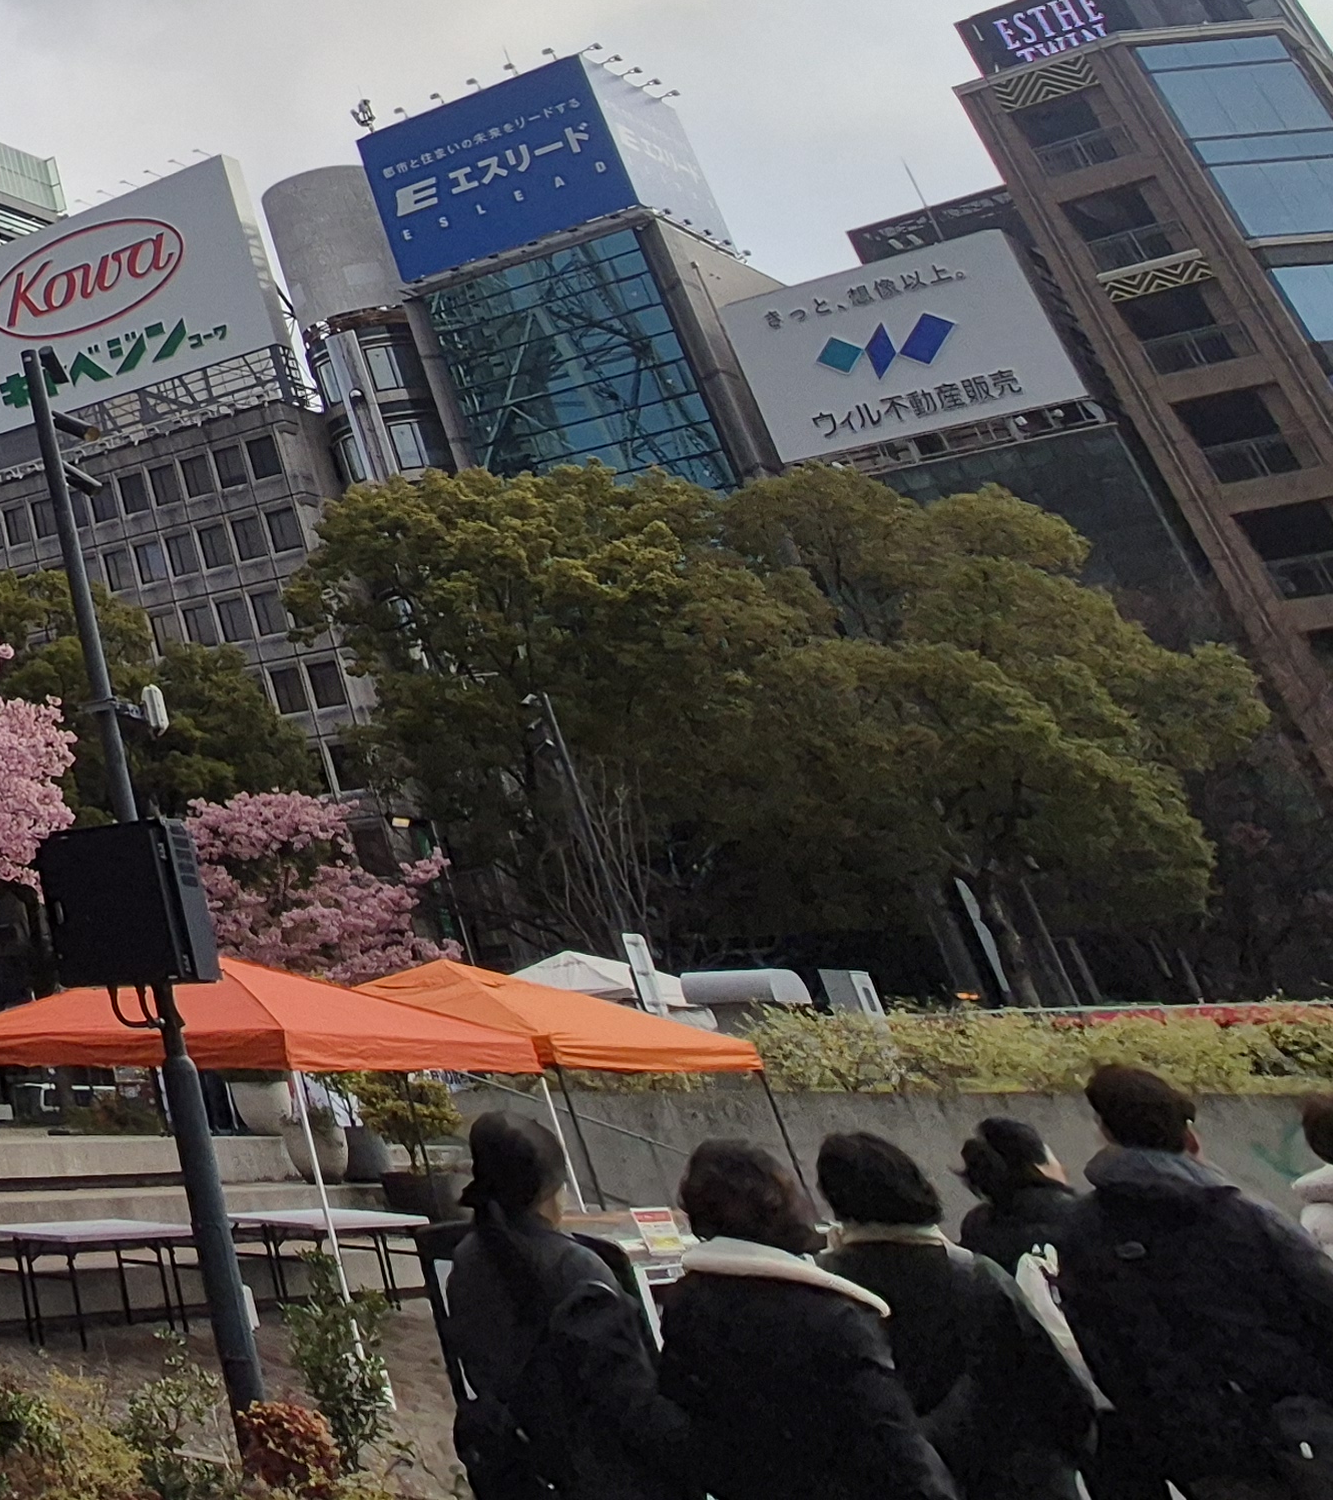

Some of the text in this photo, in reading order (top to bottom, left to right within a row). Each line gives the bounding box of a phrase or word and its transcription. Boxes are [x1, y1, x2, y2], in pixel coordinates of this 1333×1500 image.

[383, 98, 581, 179] 都市と住まいの未来をリードする
[448, 122, 589, 194] エスリード
[7, 232, 175, 328] Kowa
[764, 264, 967, 329] きっと、想像以上。
[811, 369, 1023, 439] ウィル不動産販売
